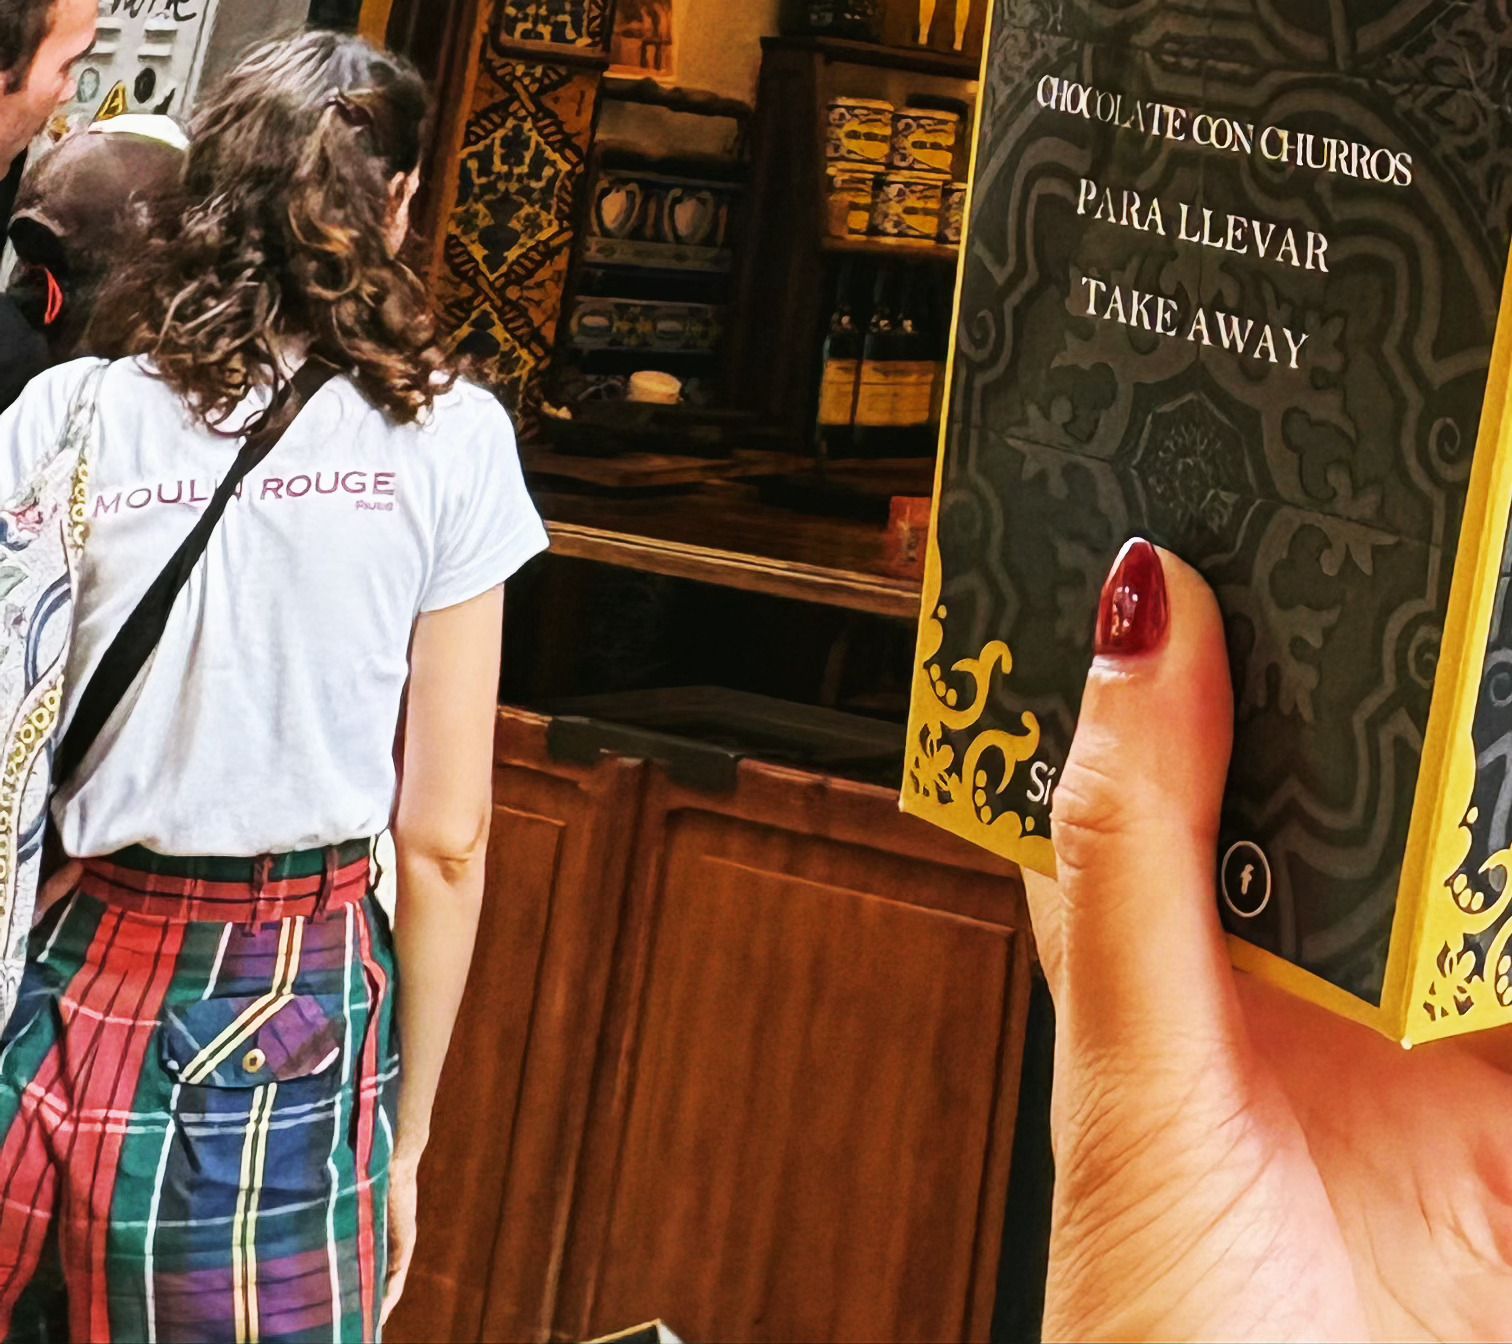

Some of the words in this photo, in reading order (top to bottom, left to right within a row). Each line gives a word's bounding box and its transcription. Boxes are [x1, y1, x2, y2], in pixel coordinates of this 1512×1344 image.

[1036, 74, 1186, 141] CHOCOLATE
[1193, 114, 1254, 154] CON
[1260, 126, 1413, 187] CHURROS
[1076, 178, 1166, 236] PARA
[1178, 202, 1330, 273] LLEVAR
[1081, 276, 1178, 337] TAKE
[1186, 308, 1310, 369] AWAY
[260, 471, 396, 502] ROUGE
